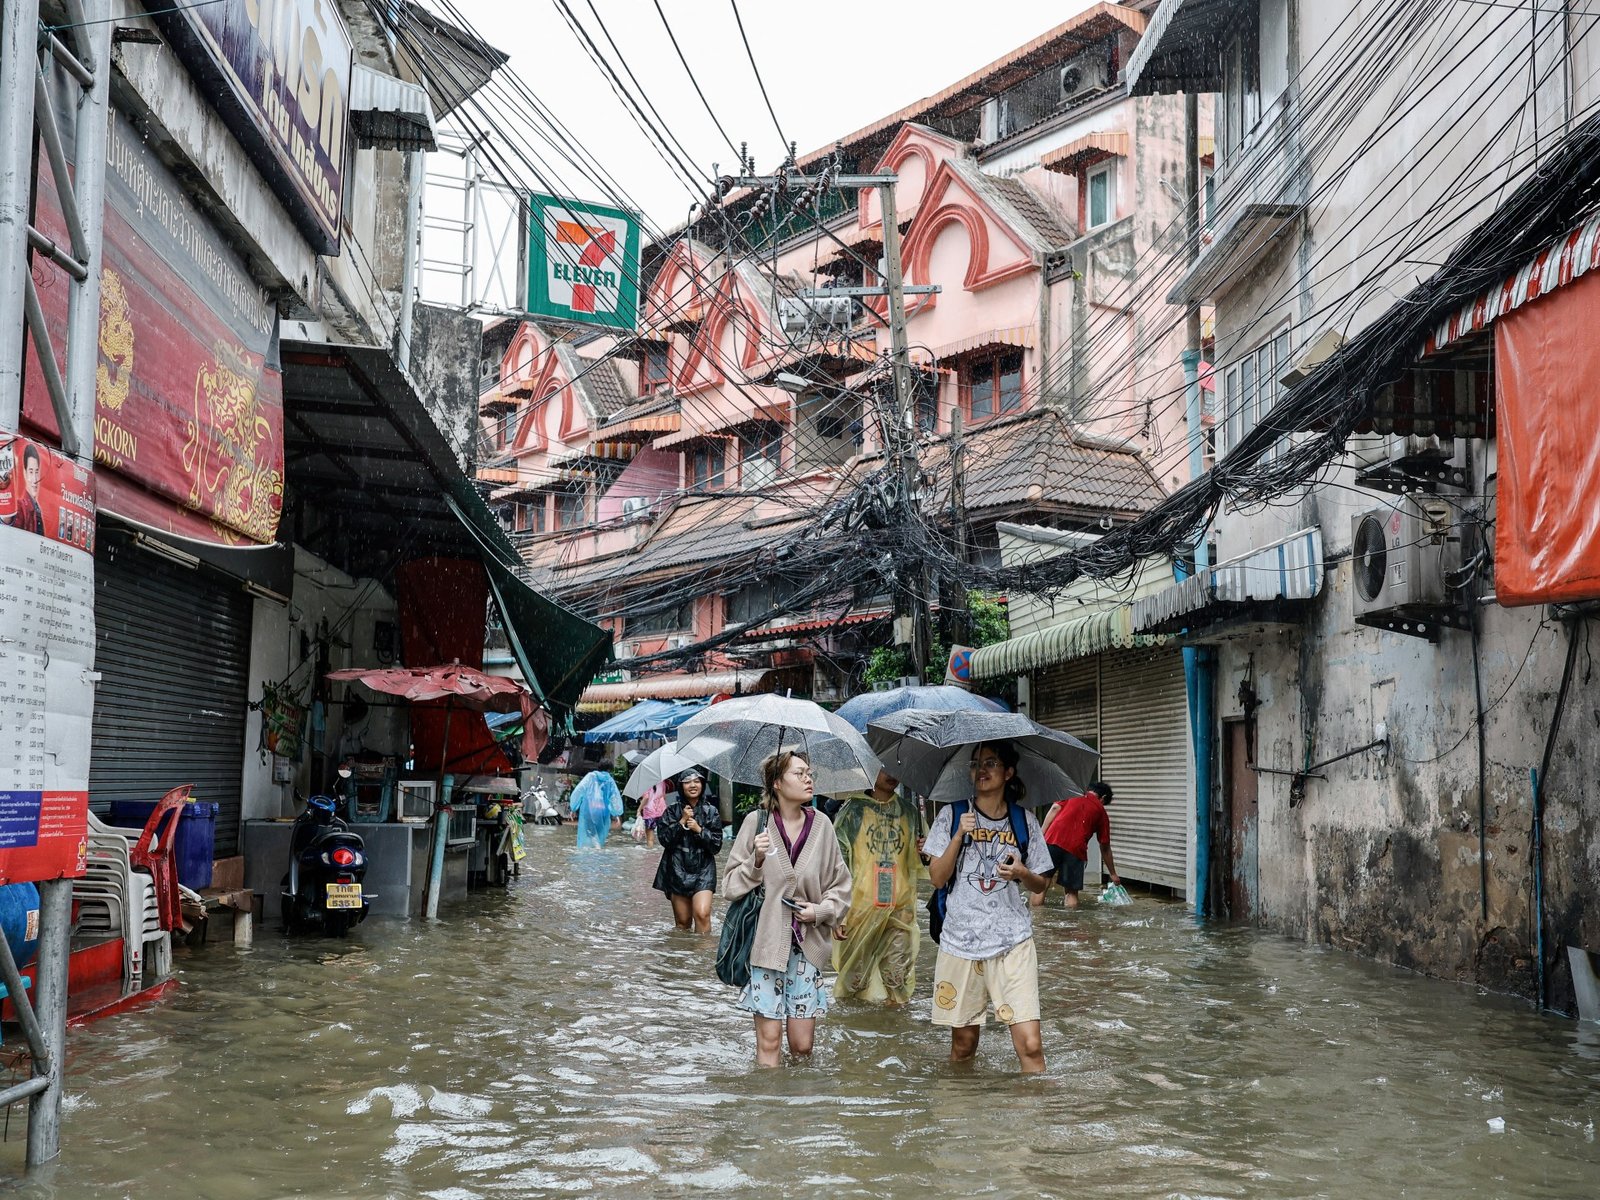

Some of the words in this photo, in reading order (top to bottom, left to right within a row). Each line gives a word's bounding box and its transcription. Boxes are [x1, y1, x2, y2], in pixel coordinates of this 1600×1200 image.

[94, 414, 138, 461] NGKORN
[1392, 537, 1400, 549] LG
[970, 828, 997, 842] NEY
[998, 831, 1018, 847] TU
